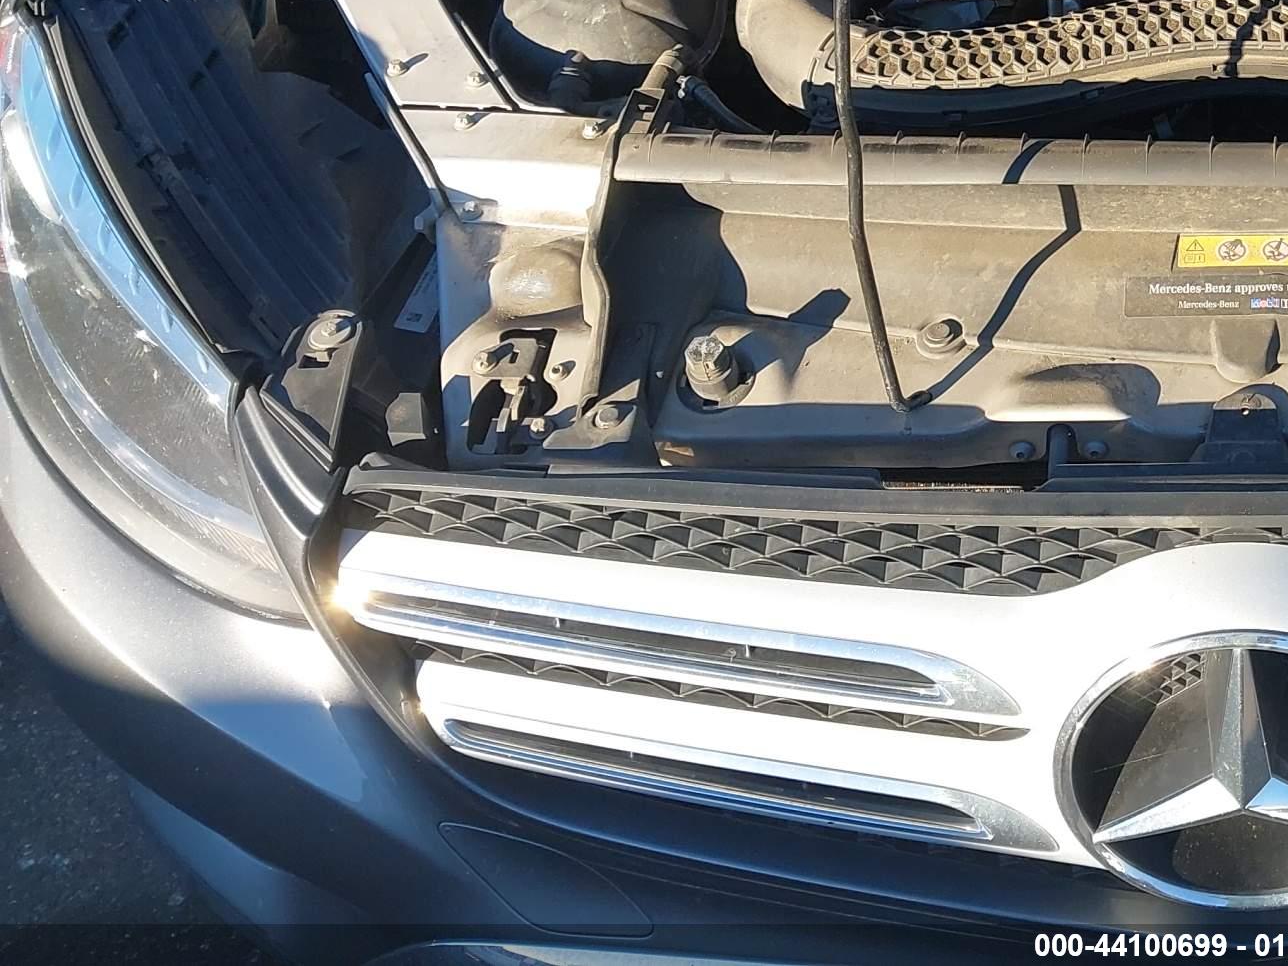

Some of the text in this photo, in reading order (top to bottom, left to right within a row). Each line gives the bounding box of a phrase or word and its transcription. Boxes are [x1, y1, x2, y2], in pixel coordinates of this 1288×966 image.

[1149, 283, 1232, 295] Mercedes-Benz
[1234, 283, 1283, 297] approves
[1178, 299, 1240, 309] Mercedes-Benz
[1250, 297, 1280, 309] Mobil
